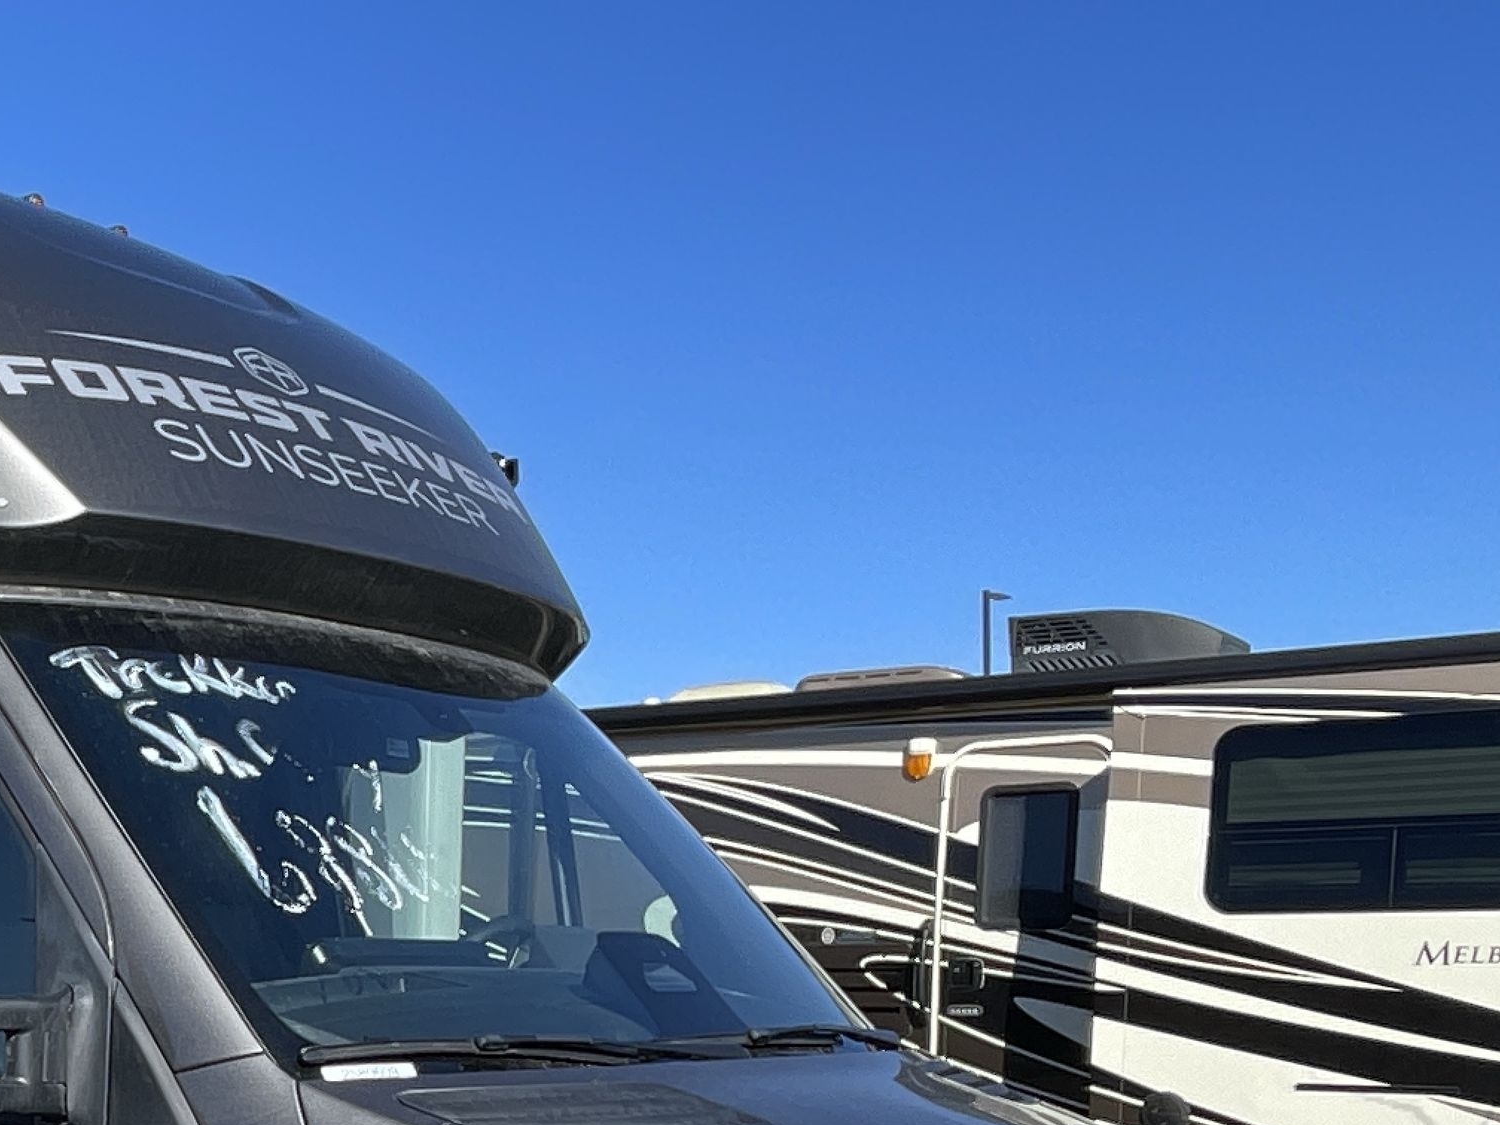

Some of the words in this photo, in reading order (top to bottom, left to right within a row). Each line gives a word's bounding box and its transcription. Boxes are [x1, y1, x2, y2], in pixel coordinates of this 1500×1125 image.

[154, 418, 500, 536] SUNSEEKER
[340, 416, 528, 525] RIVER
[1023, 641, 1087, 655] FURRION
